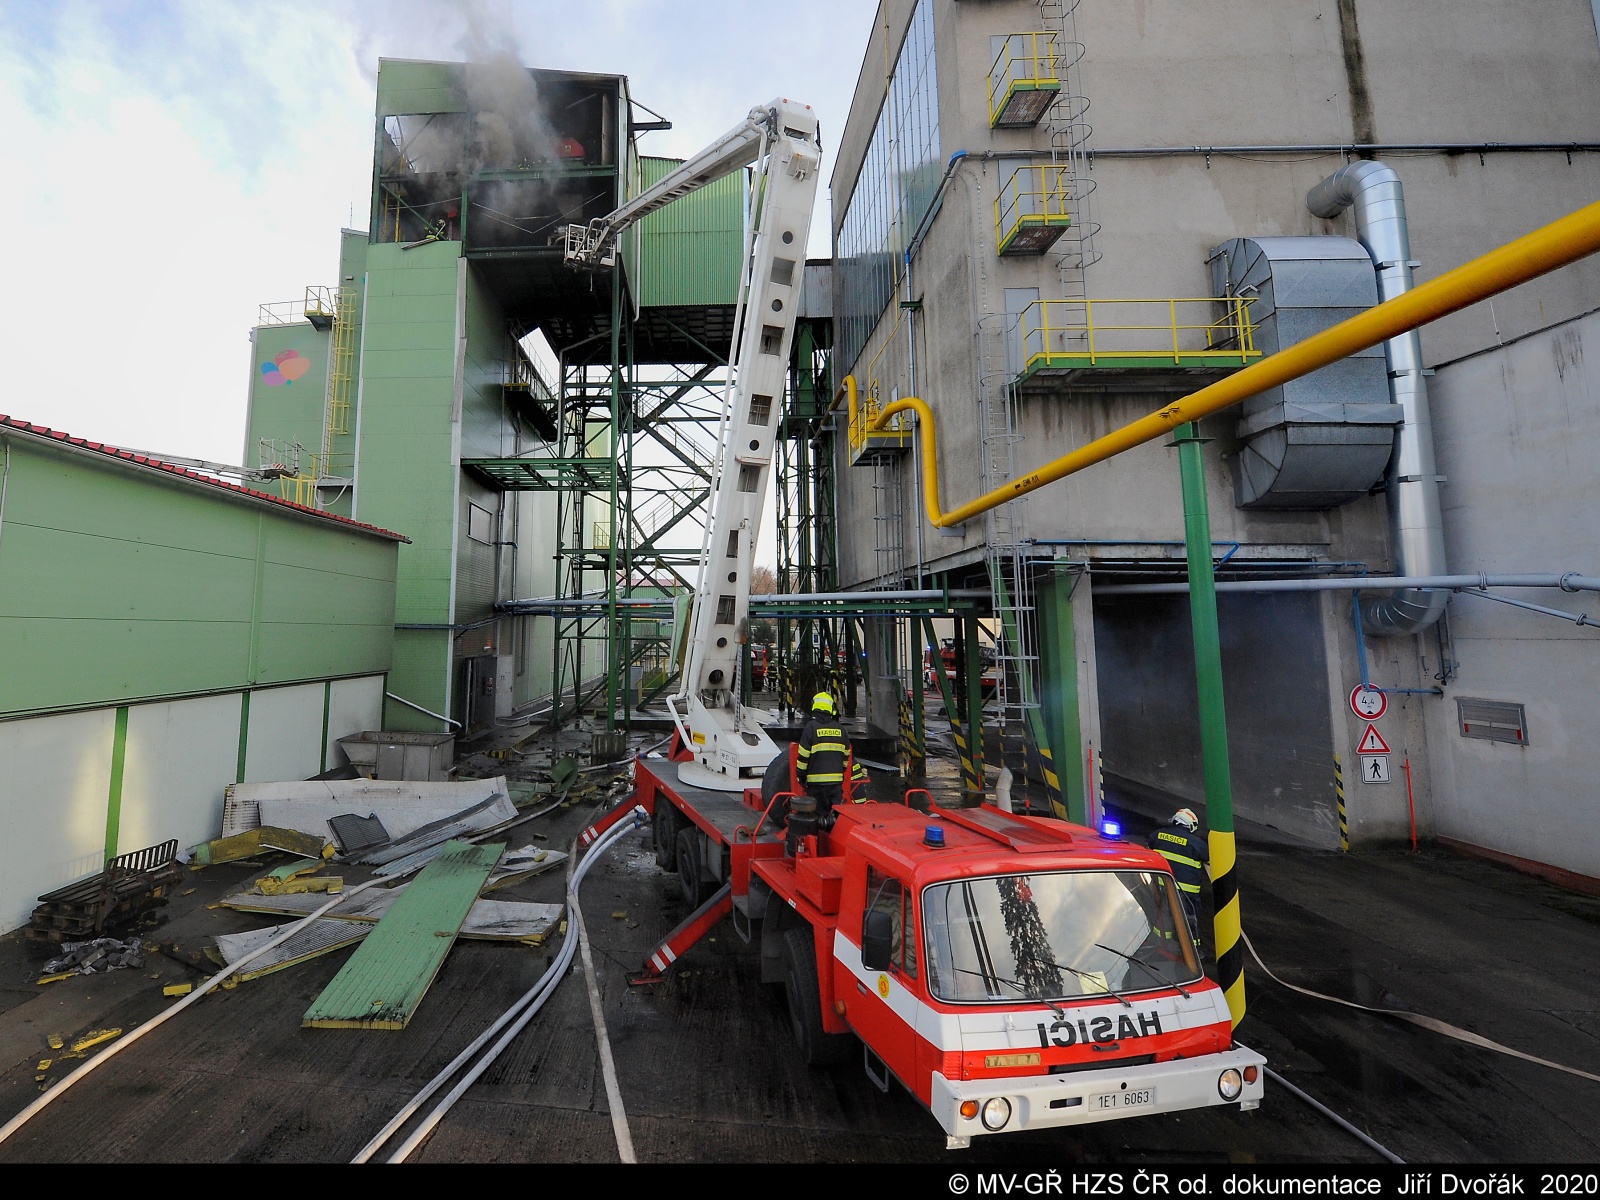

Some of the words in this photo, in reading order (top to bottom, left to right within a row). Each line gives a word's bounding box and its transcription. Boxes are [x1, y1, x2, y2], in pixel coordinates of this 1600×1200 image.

[986, 1054, 1040, 1067] TATRA
[1098, 1094, 1116, 1108] 1E1
[1124, 1091, 1149, 1105] 6063
